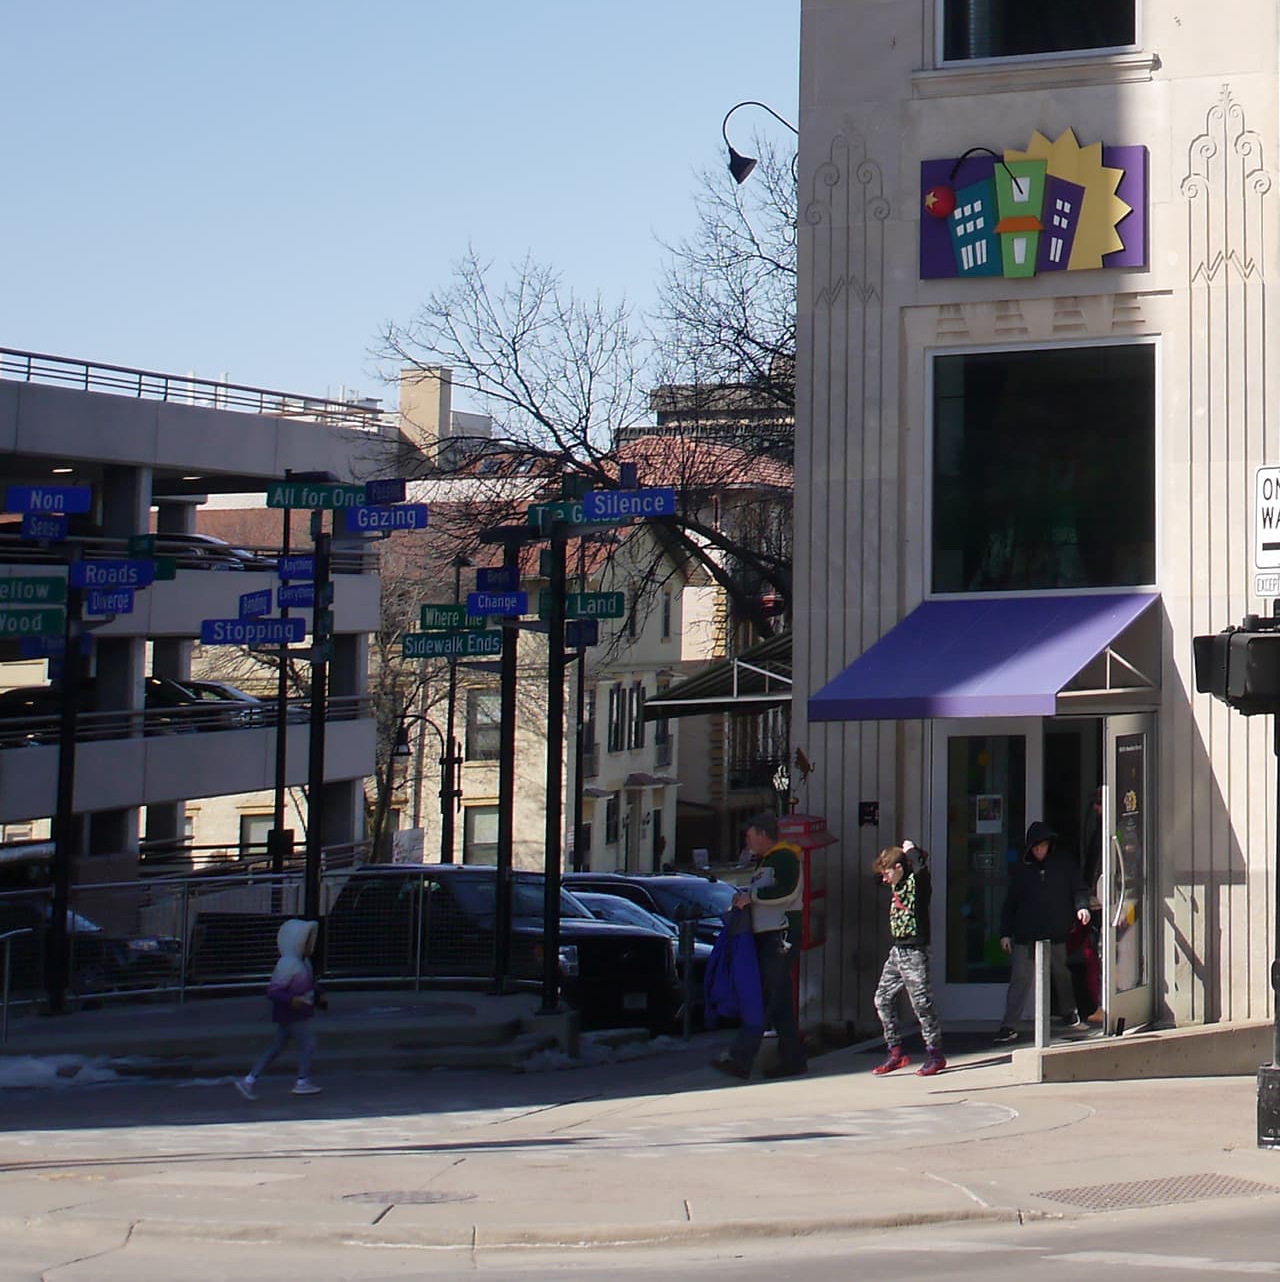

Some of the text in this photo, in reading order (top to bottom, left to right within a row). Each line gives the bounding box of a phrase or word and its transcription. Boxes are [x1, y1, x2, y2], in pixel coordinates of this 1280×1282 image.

[30, 490, 64, 510] Non
[273, 487, 294, 505] All
[302, 487, 328, 506] for
[333, 489, 366, 506] One
[594, 495, 664, 514] Silence
[30, 518, 59, 537] Sense
[358, 508, 416, 529] Gazing
[86, 564, 138, 583] Roads
[0, 581, 49, 599] ellow
[1257, 576, 1279, 593] EXCEPT
[92, 590, 129, 612] Diverge
[478, 595, 517, 613] Change
[577, 594, 616, 614] Land
[425, 607, 459, 626] Where
[213, 622, 294, 643] Stopping
[405, 633, 500, 655] Sidewalk Ends
